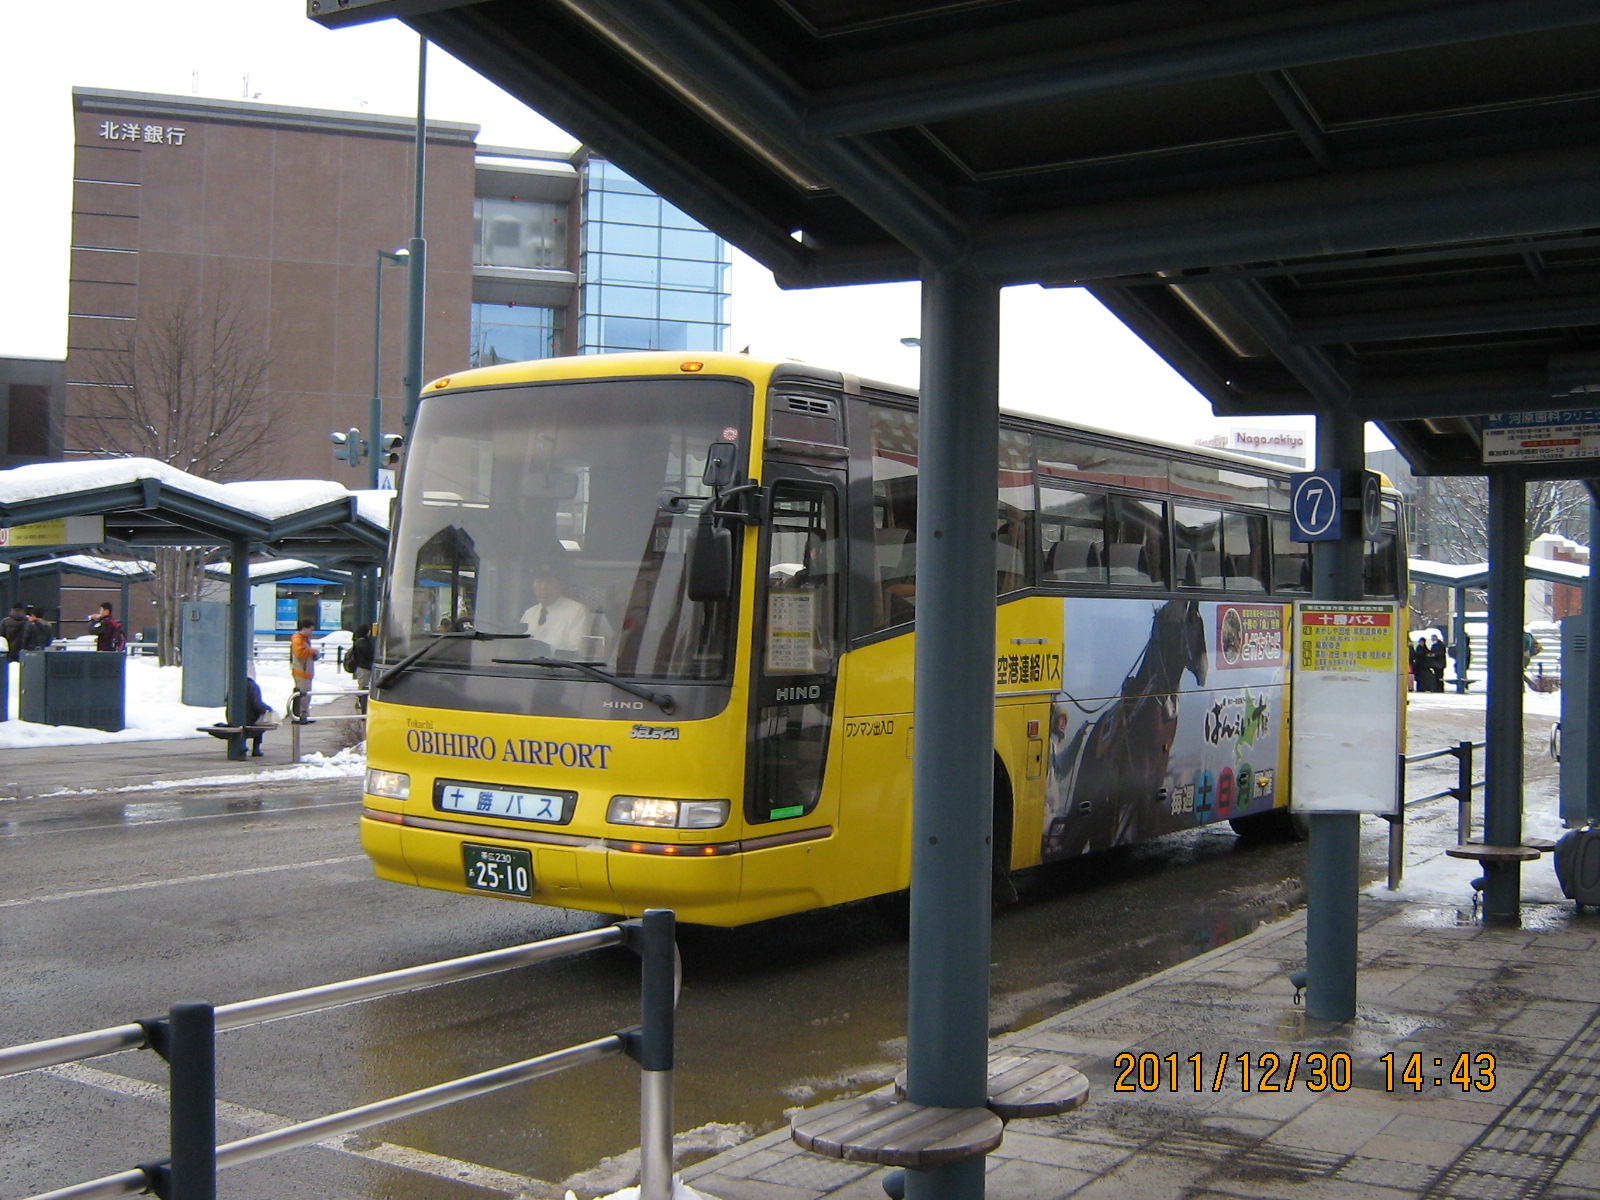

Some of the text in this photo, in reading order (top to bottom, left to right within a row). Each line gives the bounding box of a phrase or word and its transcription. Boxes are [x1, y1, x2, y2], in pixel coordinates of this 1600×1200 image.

[99, 120, 186, 146] 北洋銀行
[1236, 432, 1304, 449] Nagasakiya
[1306, 488, 1324, 526] 7
[1318, 613, 1375, 626] 十勝バス
[996, 653, 1063, 686] 空港連絡バス
[602, 700, 645, 711] HINO
[775, 685, 821, 701] HINO
[845, 719, 895, 738] ワンマン出入口
[406, 728, 613, 770] OBIHIRO AIRPORT
[449, 787, 553, 818] 十勝バス
[475, 860, 528, 892] 25-10
